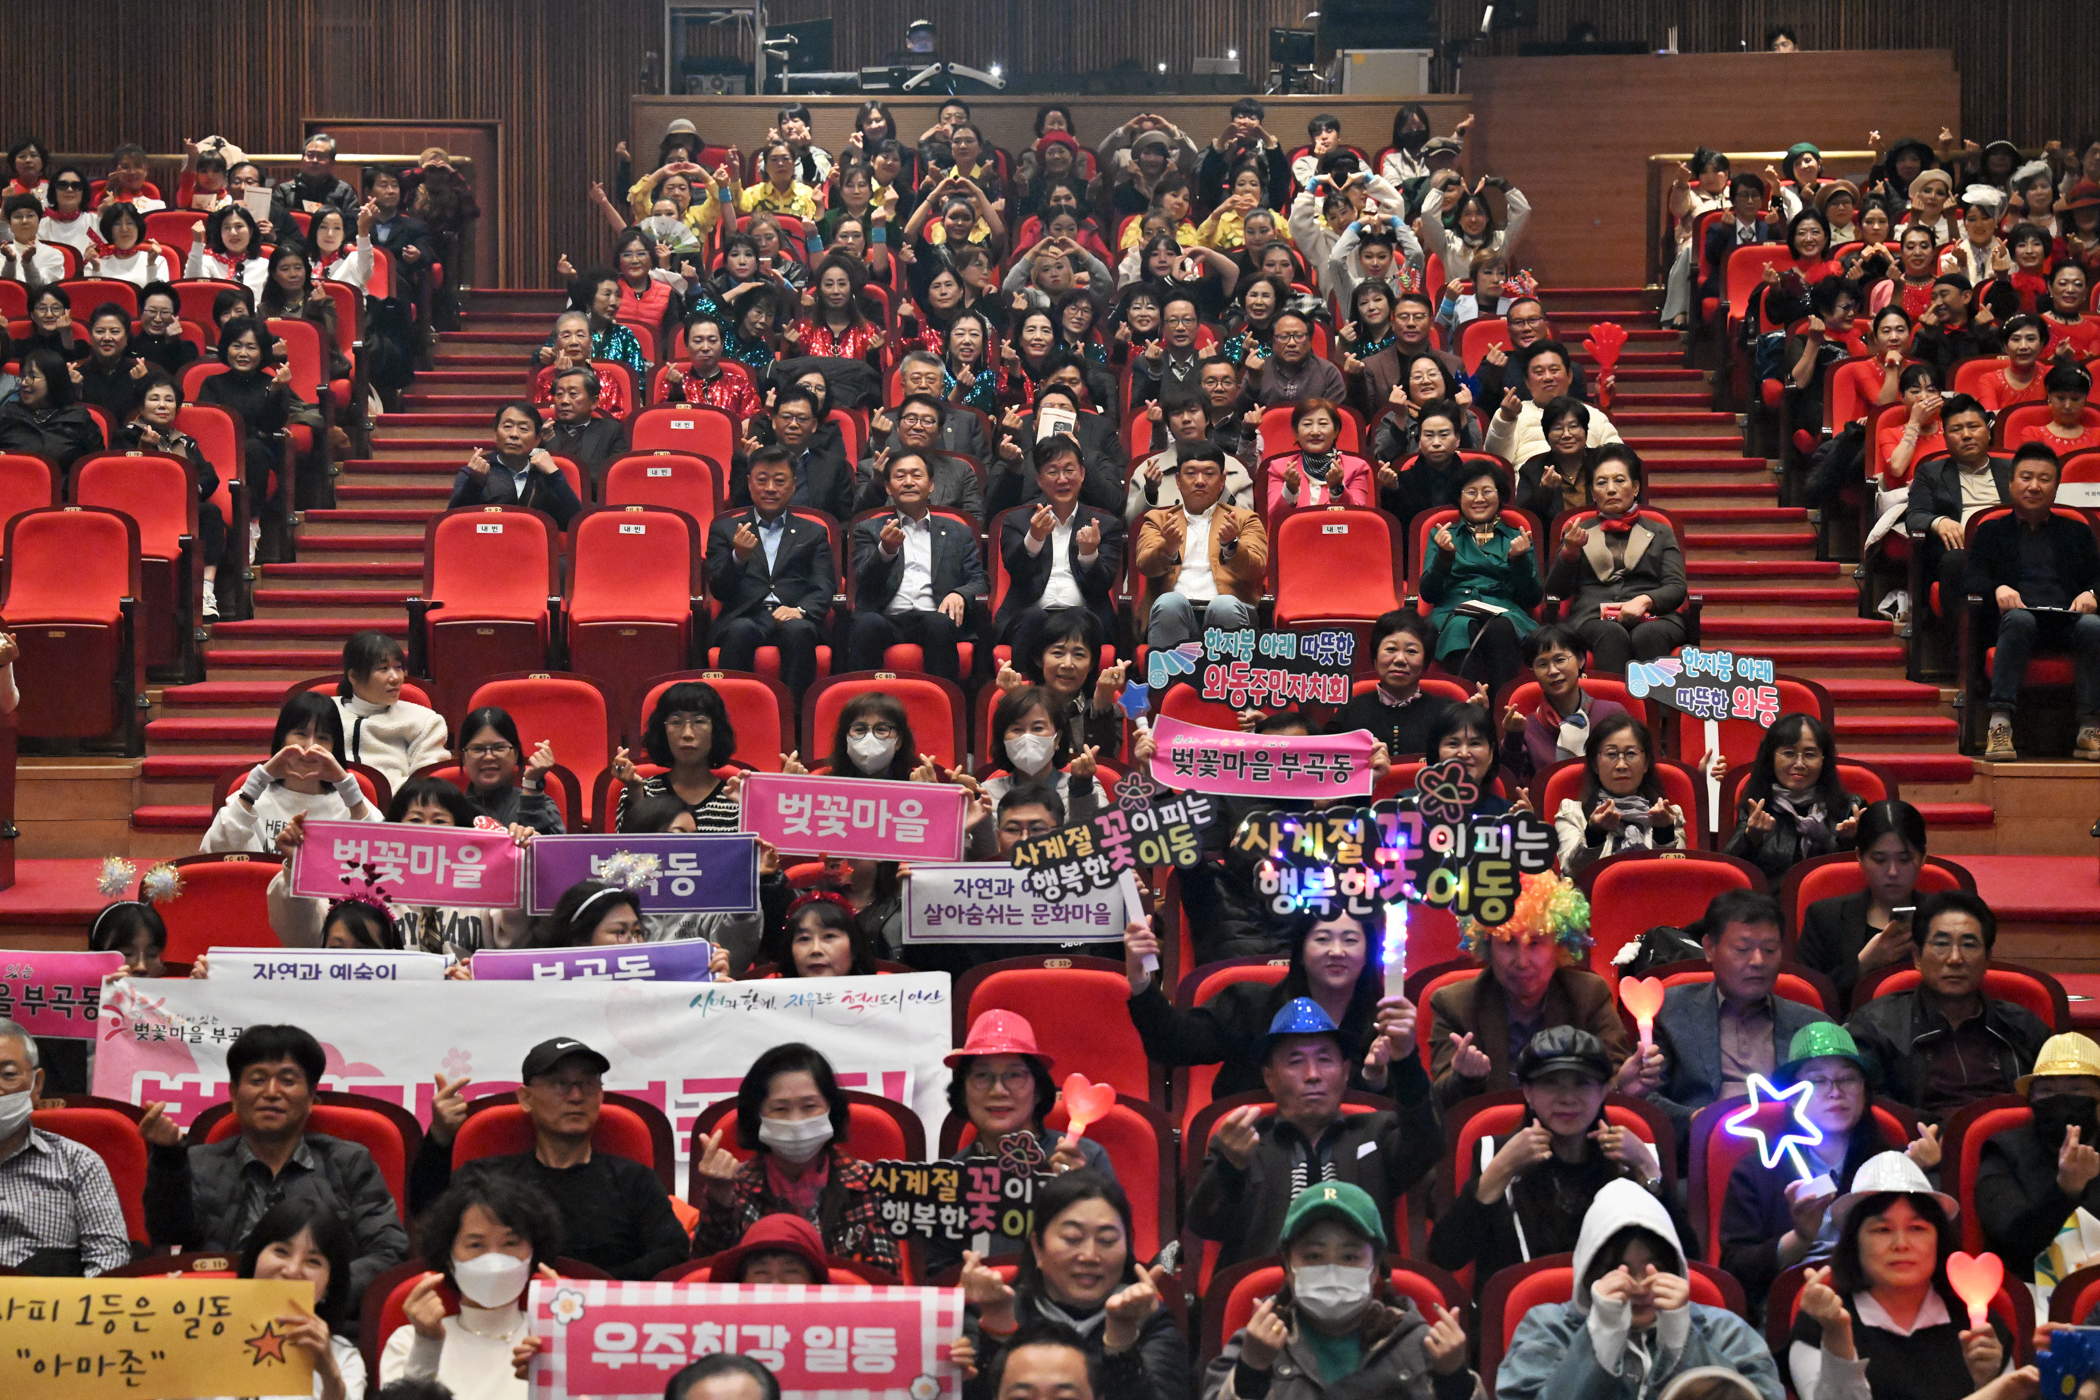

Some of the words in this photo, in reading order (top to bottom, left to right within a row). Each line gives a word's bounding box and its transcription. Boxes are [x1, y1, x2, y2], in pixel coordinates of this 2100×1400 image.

[1204, 627, 1256, 663] 한지붕
[1259, 633, 1296, 659] 아래
[1301, 631, 1355, 666] 따뜻한
[1682, 646, 1733, 682] 한지붕
[1737, 658, 1773, 684] 아래
[1202, 661, 1349, 707] 와동주민자치회
[1676, 686, 1729, 718] 따뜻한
[1732, 685, 1779, 728] 와동
[1172, 748, 1274, 781] 벚꽃마을
[1277, 753, 1354, 784] 부곡동
[778, 793, 929, 843] 벚꽃마을
[1014, 824, 1094, 867] 사계절
[1031, 854, 1111, 900] 행복한
[1139, 824, 1198, 865] 이동
[1242, 818, 1366, 864] 사계절
[333, 838, 487, 889] 벚꽃마을
[953, 878, 1014, 899] 자연과
[1259, 867, 1376, 915] 행복한
[1426, 861, 1514, 922] 이동
[924, 903, 1024, 926] 살아숨쉬는
[1031, 902, 1111, 926] 문화마을
[134, 1023, 205, 1044] 벚꽃마을
[870, 1167, 958, 1202] 사계절
[1324, 1187, 1338, 1200] R
[882, 1200, 969, 1239] 행복한
[75, 1294, 156, 1334] 1등은
[173, 1296, 232, 1339] 일동
[803, 1325, 898, 1373] 일동
